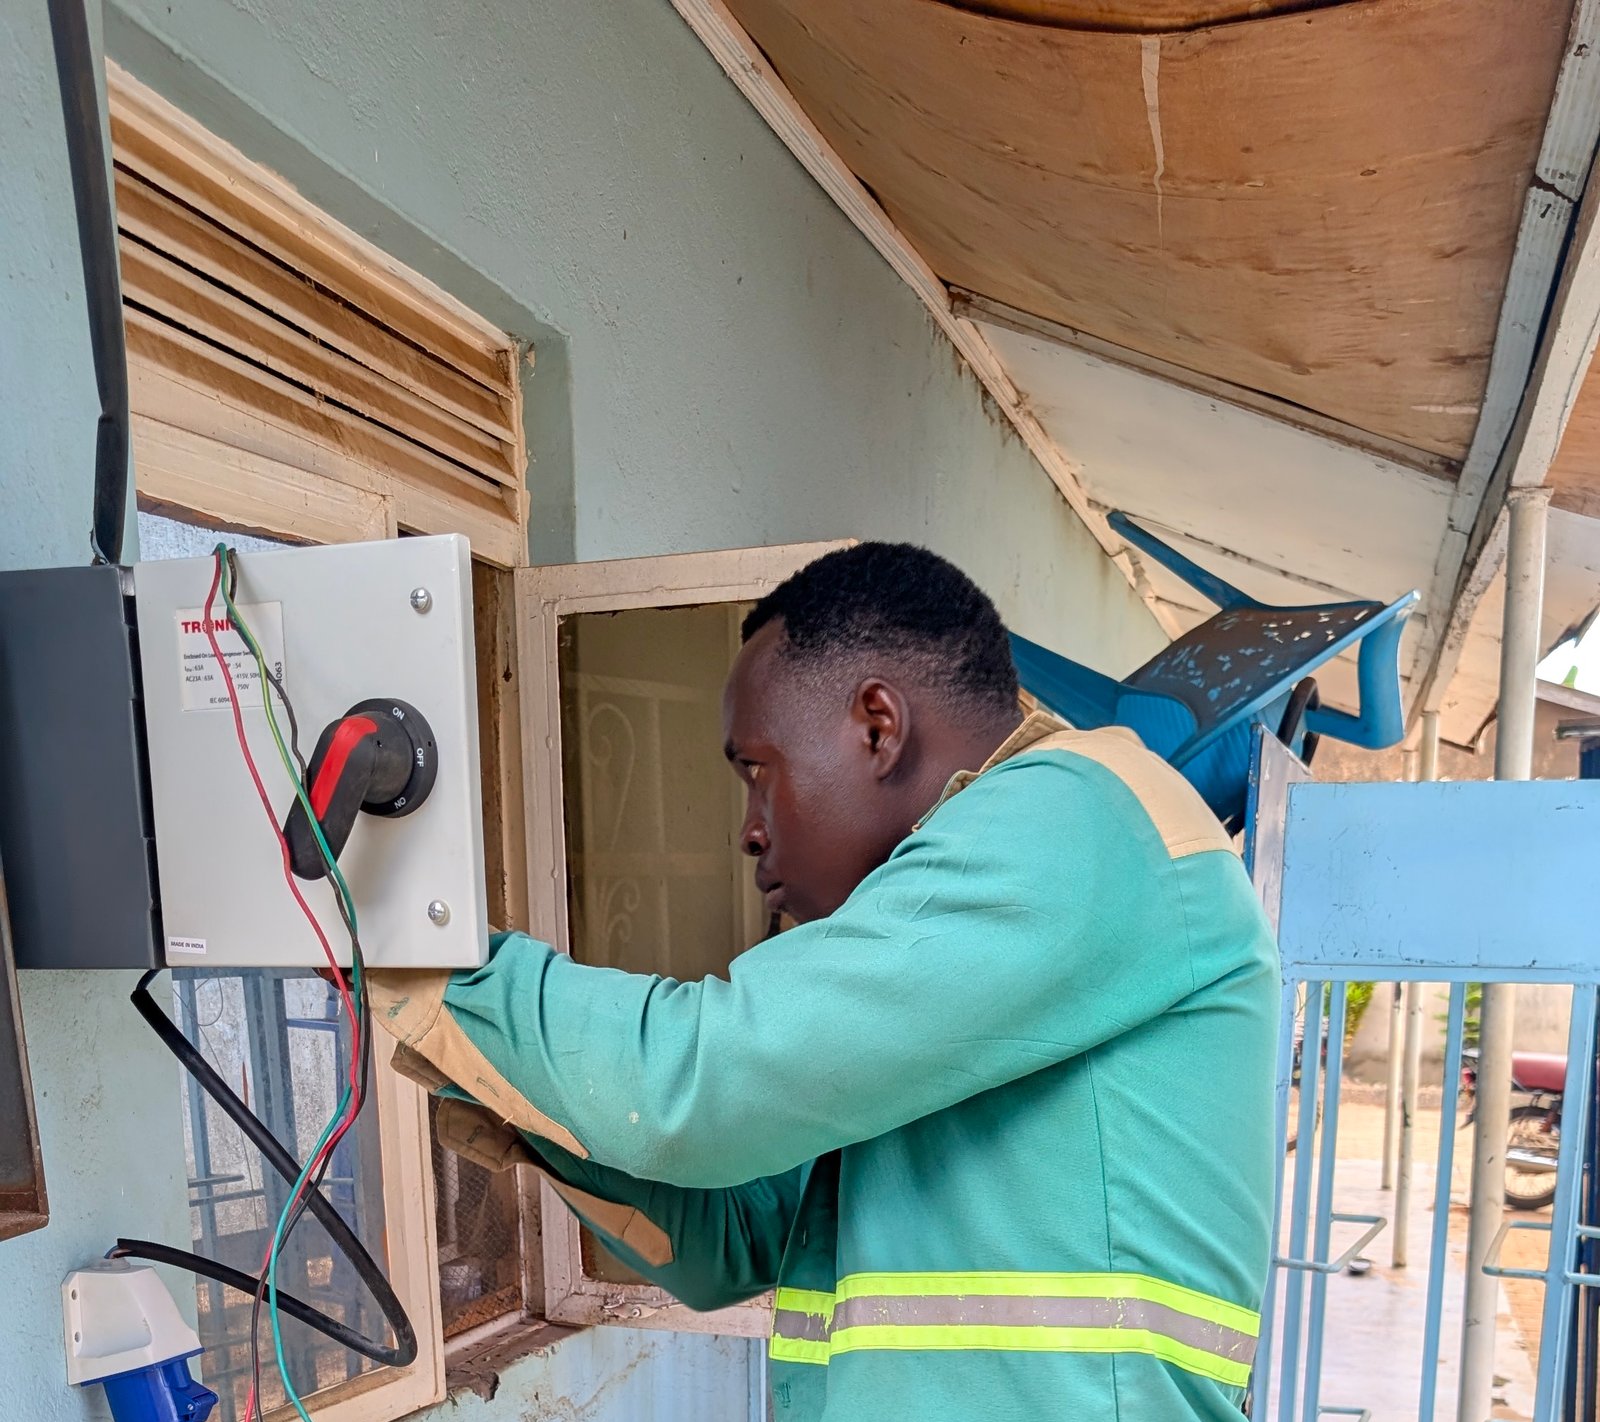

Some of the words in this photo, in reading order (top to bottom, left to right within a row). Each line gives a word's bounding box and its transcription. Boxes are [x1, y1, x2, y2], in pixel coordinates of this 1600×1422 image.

[392, 707, 405, 720] ON
[416, 747, 424, 767] OFF
[394, 797, 406, 809] ON
